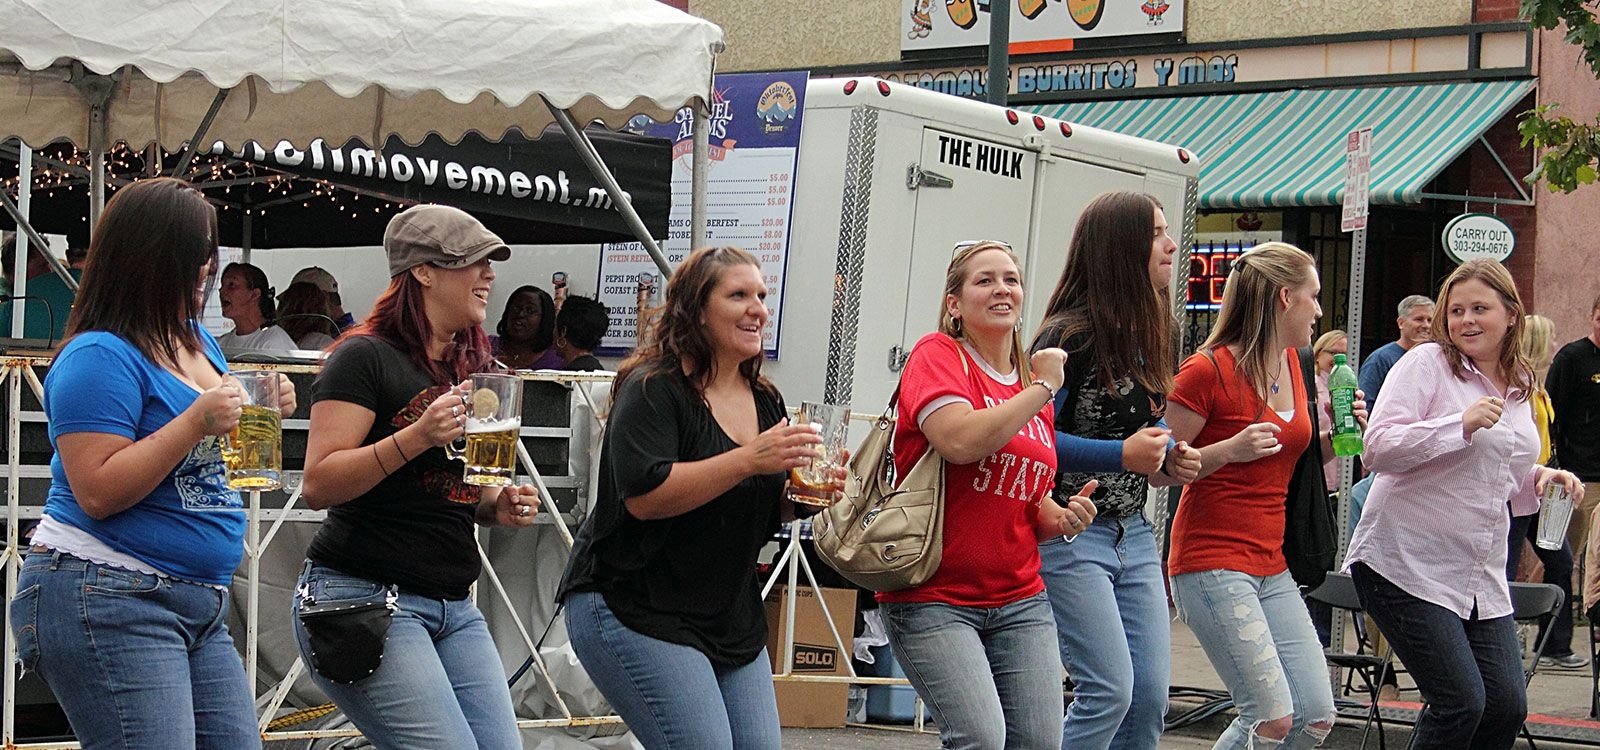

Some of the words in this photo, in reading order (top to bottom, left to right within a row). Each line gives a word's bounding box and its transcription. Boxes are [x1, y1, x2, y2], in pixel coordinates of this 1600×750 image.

[1018, 60, 1136, 93] BURRITOS
[1154, 58, 1174, 87] Y
[1178, 54, 1238, 86] MAS
[939, 135, 972, 168] THE
[976, 144, 1023, 179] HULK
[769, 174, 788, 182] $5.00
[768, 186, 787, 194] $5.00
[767, 198, 786, 206] $5.00
[764, 231, 782, 239] $8.00
[1455, 227, 1487, 241] CARRY
[1488, 230, 1508, 242] OUT
[608, 242, 628, 251] STEIN
[629, 243, 640, 251] OF
[1453, 240, 1508, 255] 303-294-0676
[605, 274, 625, 283] PEPSI
[604, 286, 631, 295] GOFAST
[796, 651, 832, 665] SOLO
